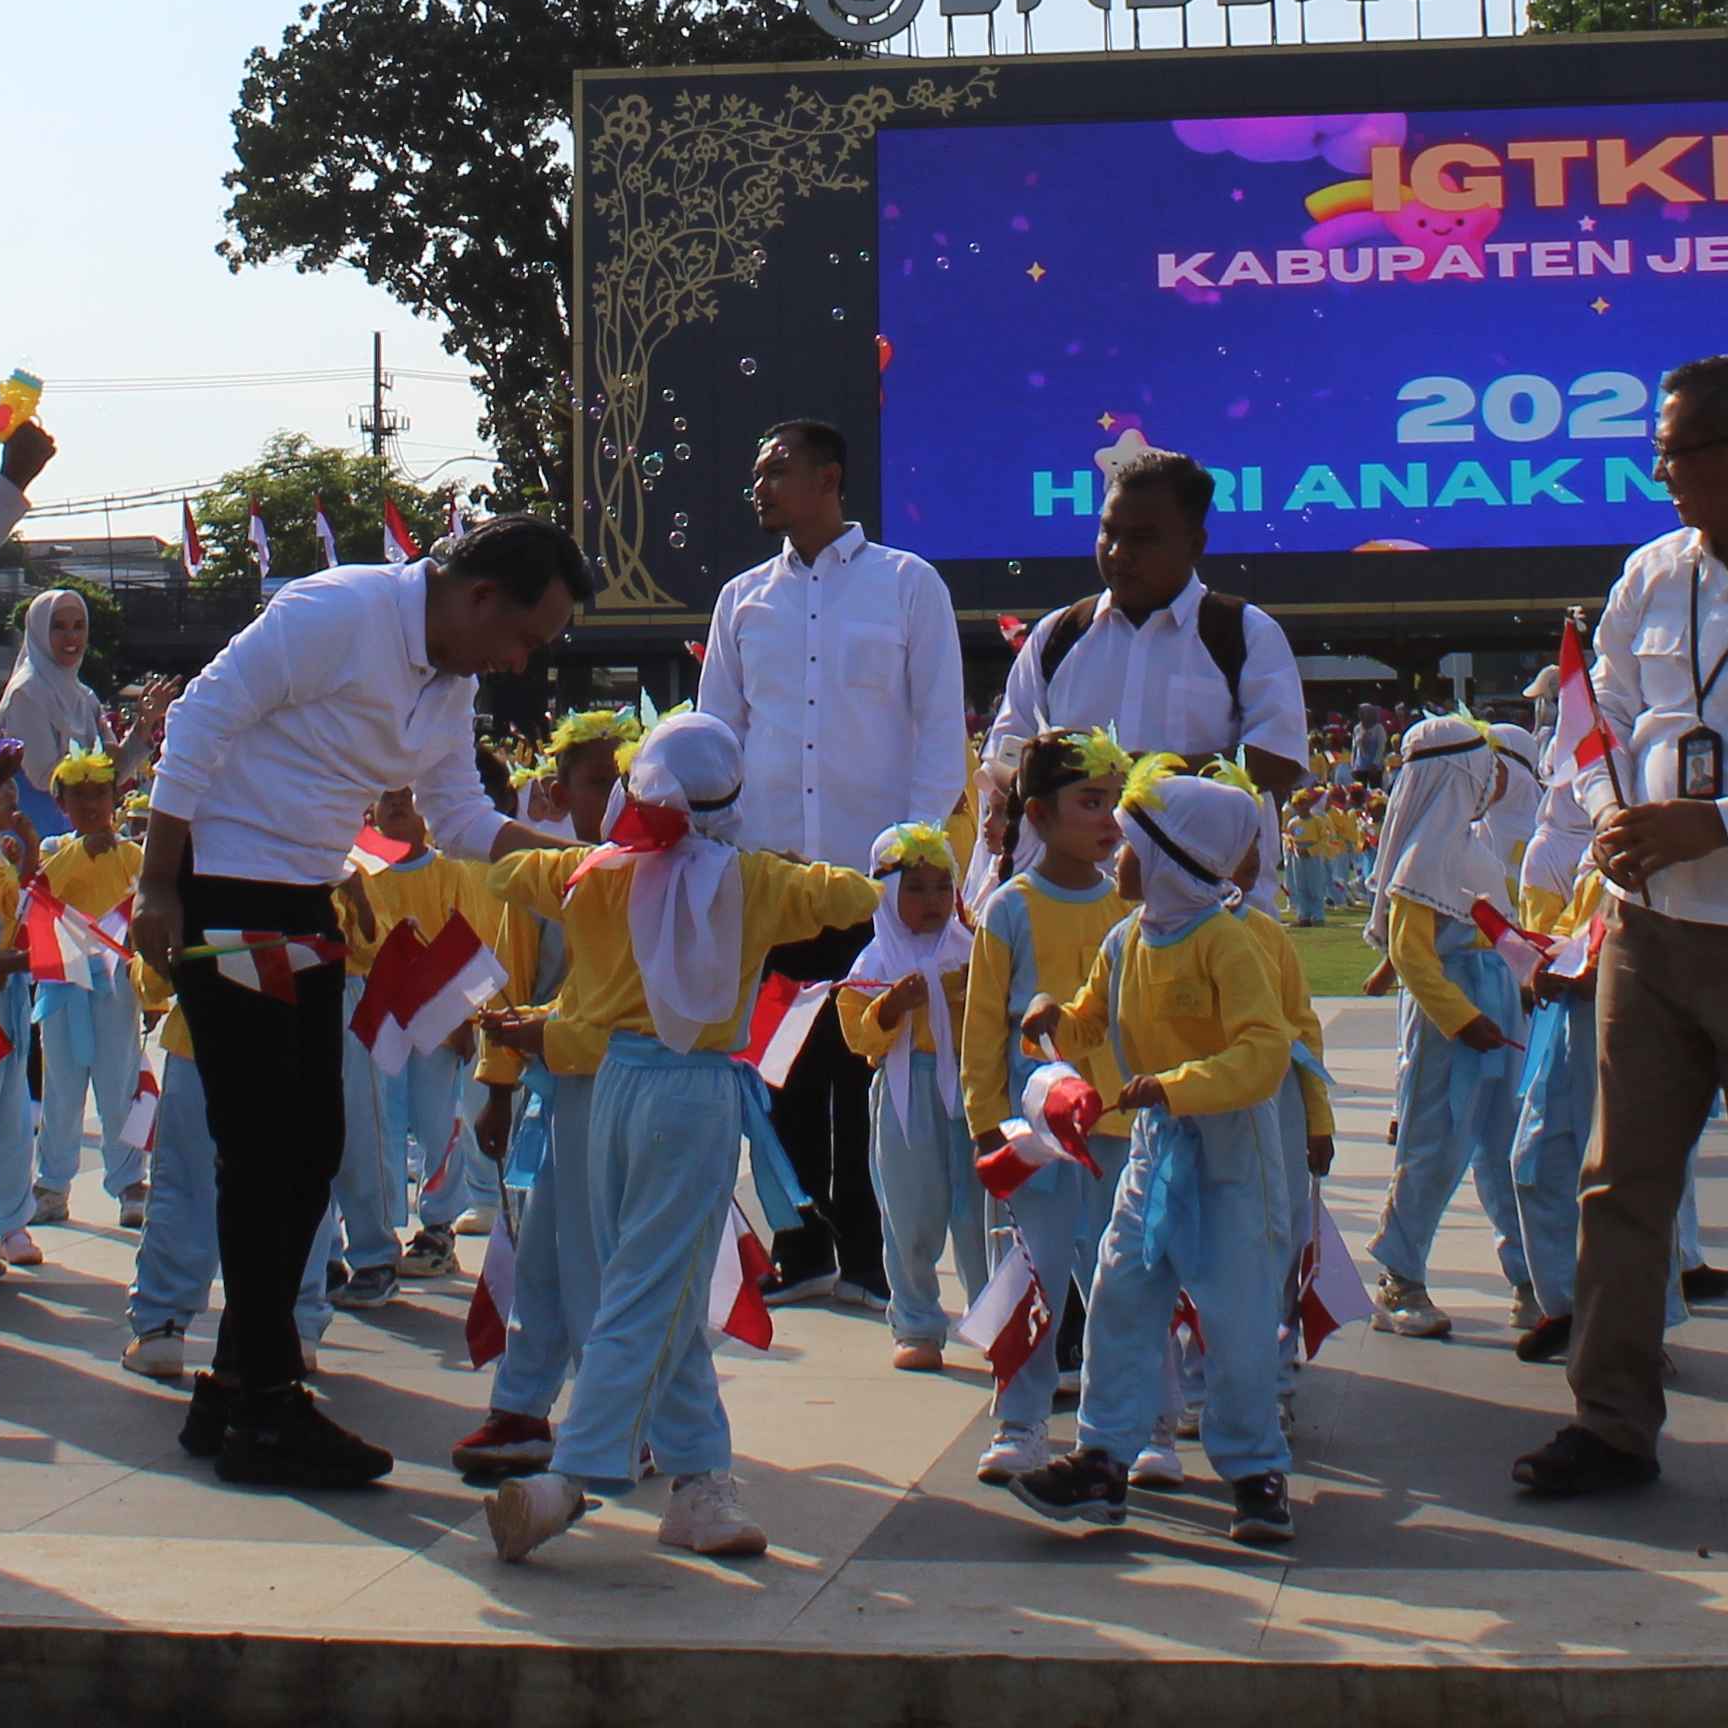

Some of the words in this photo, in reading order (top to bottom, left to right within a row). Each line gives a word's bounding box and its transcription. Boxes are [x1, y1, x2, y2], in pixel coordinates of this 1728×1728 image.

[1156, 239, 1631, 289] KABUPATEN
[1395, 370, 1671, 444] 202
[1032, 466, 1263, 516] HI
[1282, 457, 1585, 512] ANAK
